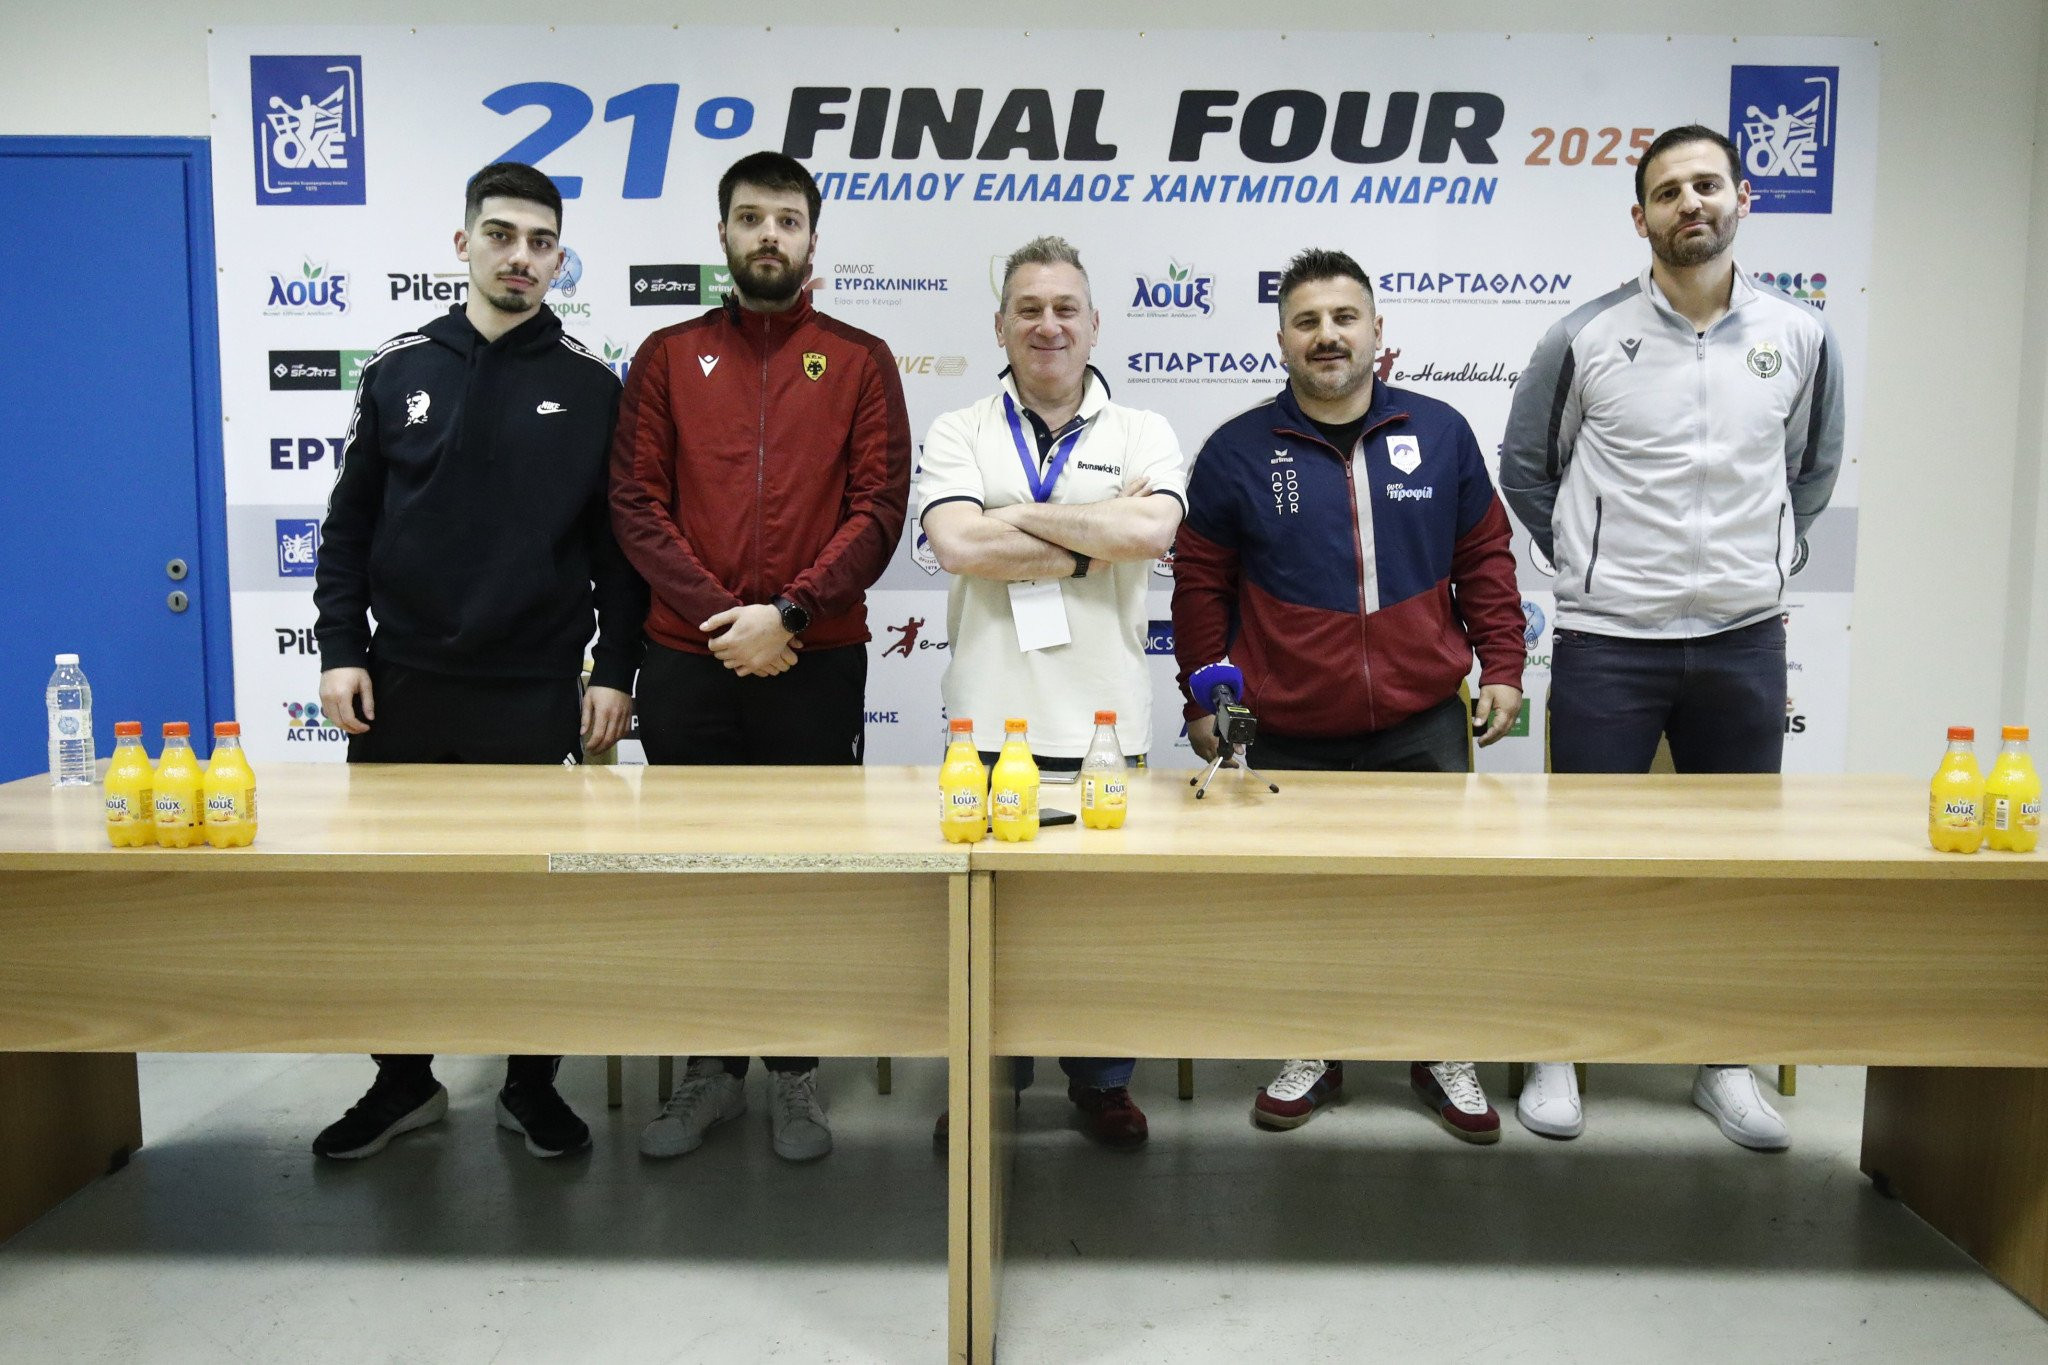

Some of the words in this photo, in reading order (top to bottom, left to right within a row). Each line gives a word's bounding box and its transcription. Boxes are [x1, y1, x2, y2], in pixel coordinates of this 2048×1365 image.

[782, 87, 1118, 162] FINAL
[1169, 89, 1505, 164] FOUR
[1524, 127, 1655, 166] 2025
[811, 172, 965, 201] ΠΕΛΛΟΥ
[973, 173, 1135, 202] ΕΛΛΑΔΟΣ
[1142, 174, 1339, 203] ΧΑΝΤΜΠΟΛ
[1350, 176, 1499, 204] ΑΝΔΡΩΝ
[834, 264, 875, 274] ΟΜΙΛΟΣ
[267, 275, 346, 312] λουξ
[387, 273, 470, 301] Piten
[650, 281, 696, 292] SPORTS
[835, 278, 949, 291] ΕΥΡΩΚΛΙΝΙΚΗΣ
[1379, 272, 1572, 294] ΣΠΑΡΤΑΘΛΟΝ
[1131, 277, 1211, 314] λουξ
[290, 366, 337, 377] SPORTS
[1127, 352, 1288, 373] ΣΠΑΡΤΑΘΛ
[1395, 362, 1522, 389] e-Handball.g
[1286, 469, 1299, 513] DOOR
[287, 728, 314, 741] ACT
[1945, 803, 1974, 815] λουξ
